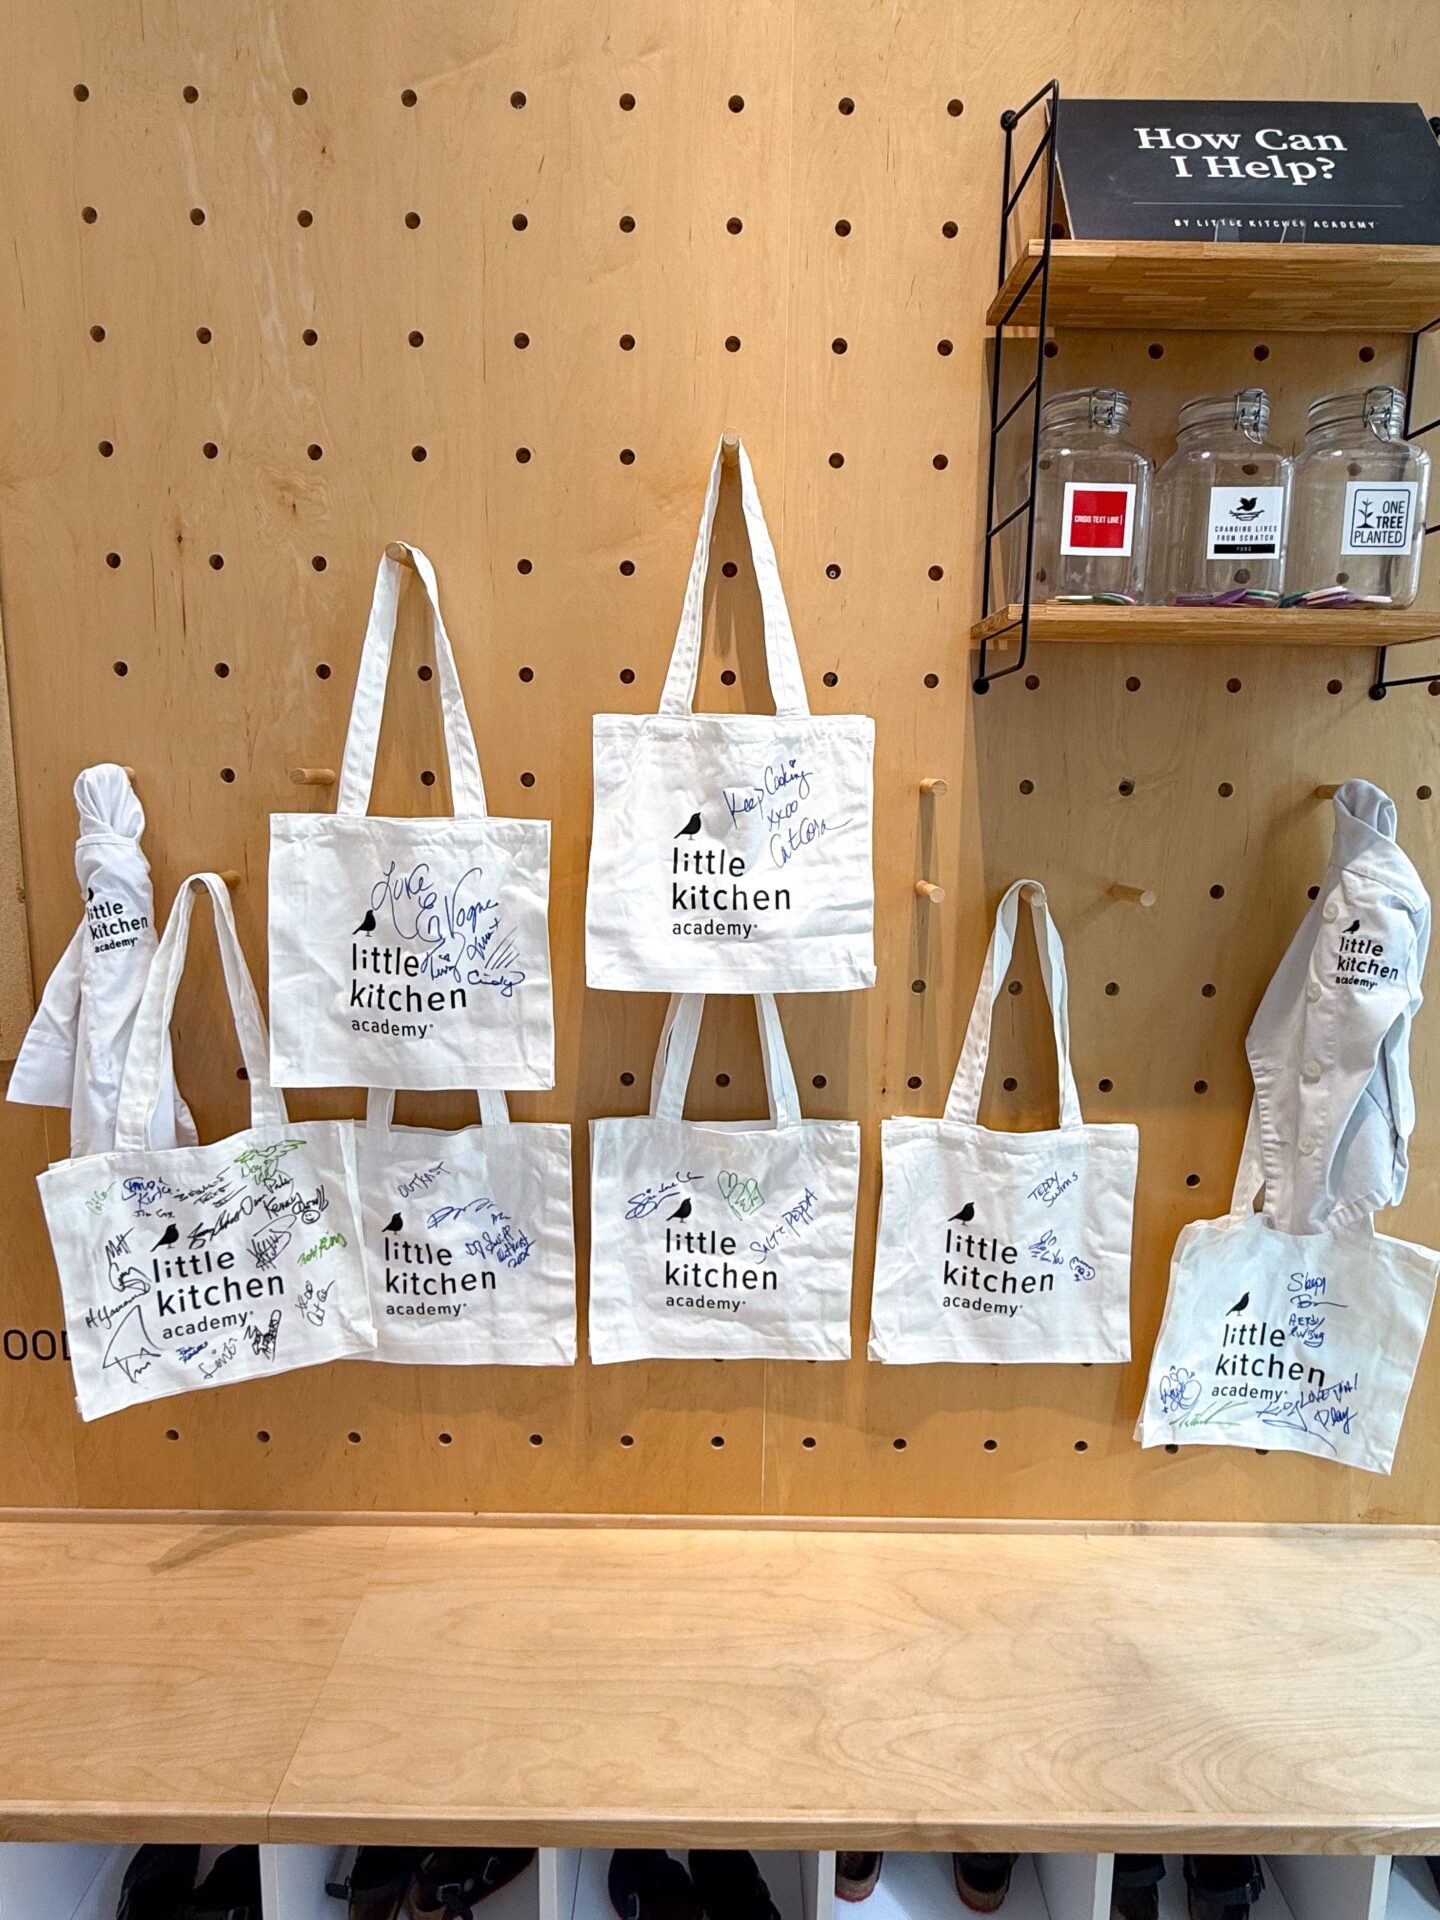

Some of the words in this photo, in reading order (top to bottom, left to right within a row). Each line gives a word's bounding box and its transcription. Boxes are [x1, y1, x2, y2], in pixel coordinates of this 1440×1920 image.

[1133, 127, 1241, 150] How
[1254, 128, 1348, 152] Can
[1169, 154, 1193, 178] I
[1201, 155, 1337, 187] Help?
[1174, 218, 1190, 227] BY
[1196, 218, 1243, 228] LITTLE
[1313, 220, 1376, 230] ACADEMY
[1092, 515, 1107, 524] TEXT
[1382, 500, 1406, 515] ONE
[1214, 525, 1252, 533] CHANGING
[1255, 525, 1278, 533] LIVES
[1376, 515, 1404, 529] TREE
[1216, 534, 1236, 542] FROM
[1239, 534, 1274, 542] SCRATCH
[1353, 530, 1403, 544] PLANTED
[672, 847, 746, 878] little
[671, 882, 792, 911] kitchen
[86, 901, 124, 922] little
[88, 916, 149, 941] kitchen
[671, 918, 757, 940] academy
[94, 937, 138, 954] academy
[1338, 936, 1384, 957] little
[352, 943, 420, 977] little
[1336, 955, 1399, 981] kitchen
[350, 978, 467, 1013] kitchen
[1335, 975, 1377, 991] academy
[351, 1018, 432, 1039] academy
[385, 1237, 453, 1266] little
[665, 1227, 737, 1256] little
[945, 1228, 1019, 1265] little
[153, 1250, 236, 1283] little
[665, 1260, 778, 1290] kitchen
[943, 1260, 1055, 1294] kitchen
[385, 1268, 497, 1296] kitchen
[156, 1274, 286, 1318] kitchen
[665, 1294, 745, 1313] academy
[942, 1295, 1022, 1318] academy
[386, 1302, 466, 1317] academy
[162, 1311, 252, 1340] academy
[1222, 1321, 1286, 1348] little
[1214, 1352, 1326, 1388] kitchen
[1211, 1382, 1287, 1404] academy
